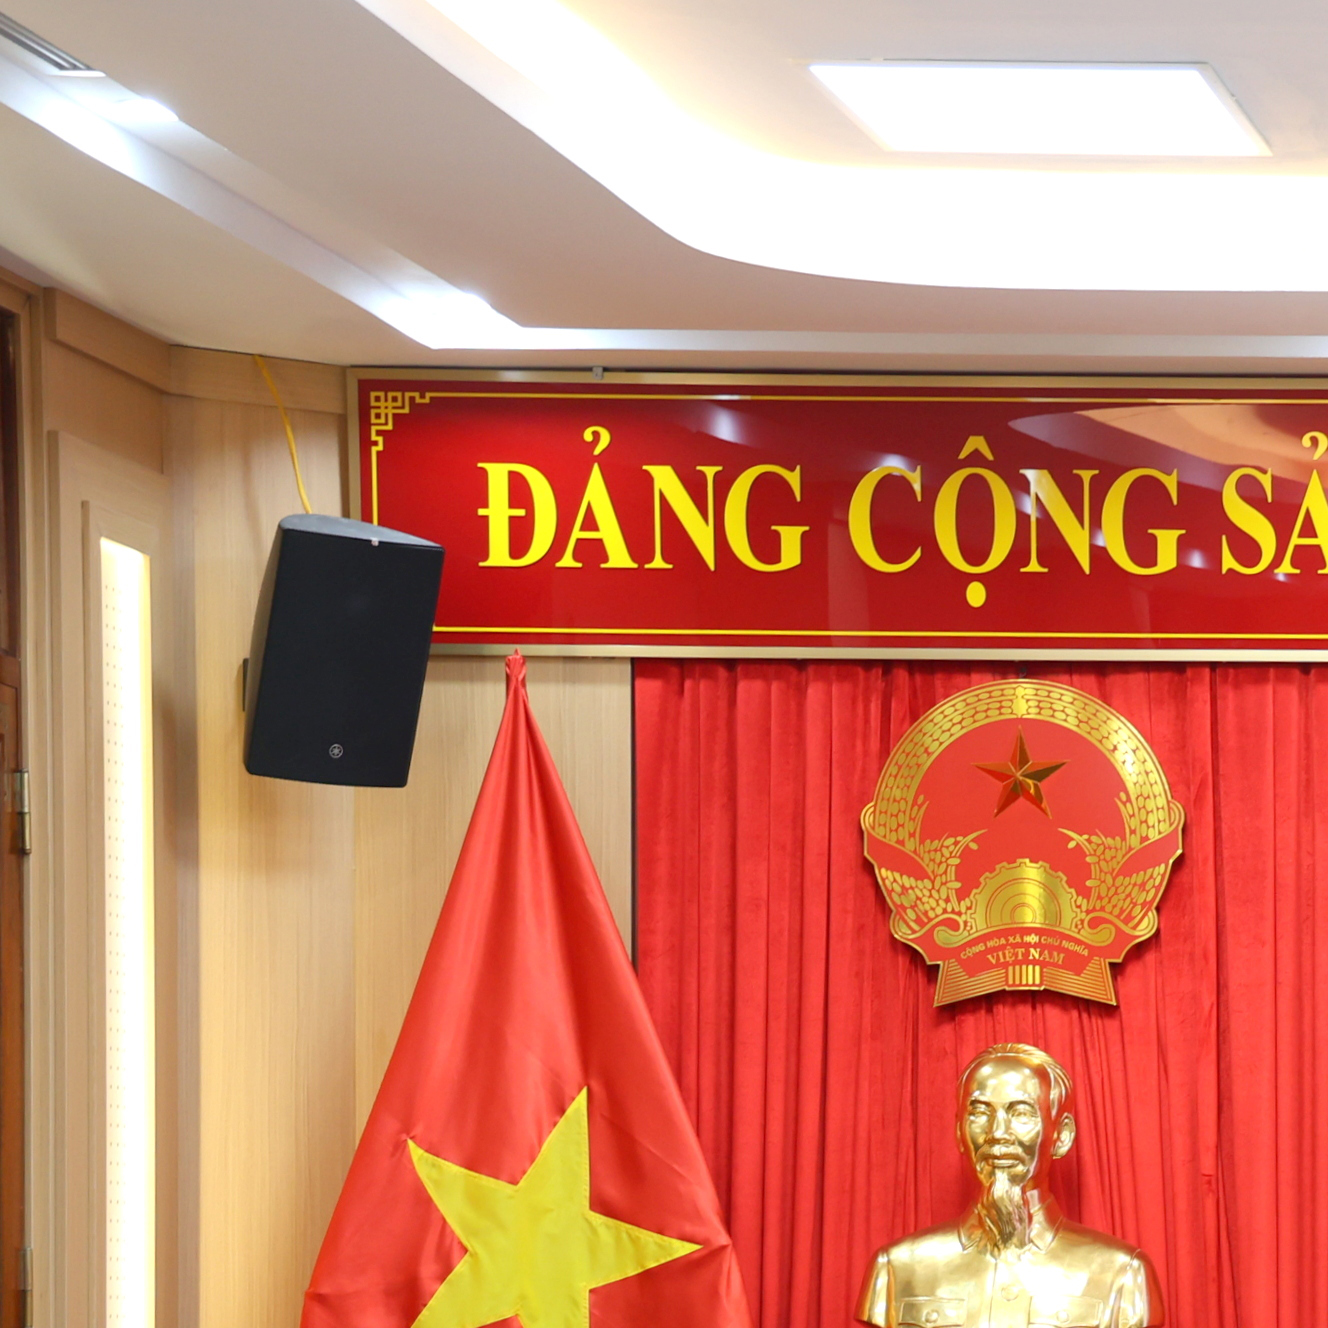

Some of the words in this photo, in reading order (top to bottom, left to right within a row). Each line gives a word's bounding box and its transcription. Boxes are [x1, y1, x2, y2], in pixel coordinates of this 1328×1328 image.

[477, 424, 809, 572] ĐẢNG
[848, 434, 1185, 608] CỘNG
[960, 943, 985, 959] CỘNG
[987, 937, 1006, 948] HÒA
[1008, 934, 1021, 943] XÃ
[1023, 933, 1039, 946] HỘI
[1041, 936, 1060, 945] CHỦ
[1062, 940, 1089, 956] NGHĨA
[987, 946, 1025, 964] VIỆT
[1028, 948, 1065, 964] NAM
